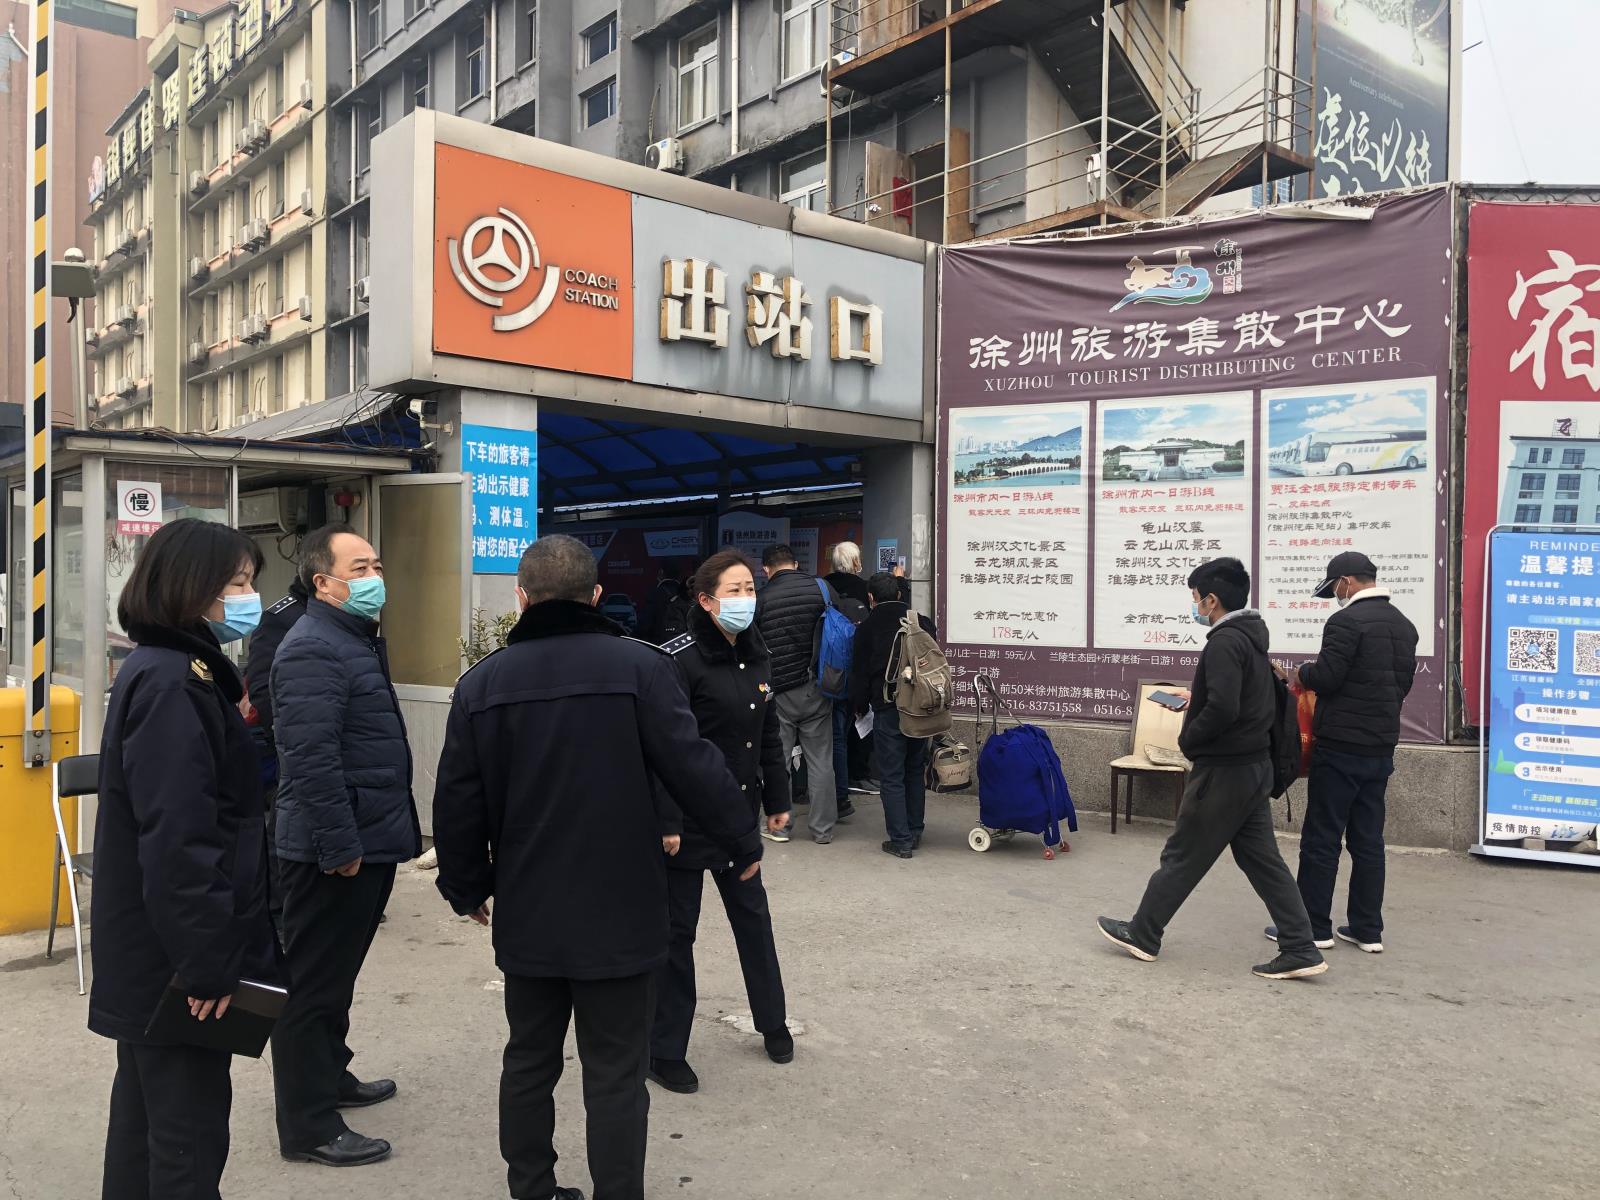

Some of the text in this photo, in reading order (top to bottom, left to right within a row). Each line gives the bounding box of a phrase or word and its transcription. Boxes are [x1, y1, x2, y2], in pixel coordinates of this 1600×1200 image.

[565, 269, 618, 291] COACH
[565, 287, 619, 310] STATION
[659, 256, 883, 367] 出站口
[968, 298, 1413, 370] 徐州旅游集散中心
[984, 345, 1402, 391] XUZHOU TOURIST DISTRIBUTING CENTER
[466, 441, 530, 467] 下车的旅客请
[130, 493, 149, 511] 慢
[1267, 510, 1353, 521] 徐州旅游集散中心
[1141, 521, 1205, 535] 龟山汉墓
[967, 540, 1067, 552] 徐州汉文化景区
[1123, 539, 1222, 551] 云龙山风景区
[974, 557, 1059, 569] 云龙湖风景区
[1520, 555, 1600, 576] 温馨提
[960, 573, 1074, 585] 淮海战役烈士陵园
[973, 610, 1059, 622] 全市统一优惠价
[991, 626, 1040, 641] 178元/人
[1143, 631, 1199, 647] 248元/人
[1000, 684, 1131, 701] 前50米徐州旅游集散中心
[1542, 688, 1590, 701] 操作步骤
[1522, 736, 1530, 747] 2
[1522, 767, 1530, 777] 3
[1492, 822, 1541, 836] 疫情防控
